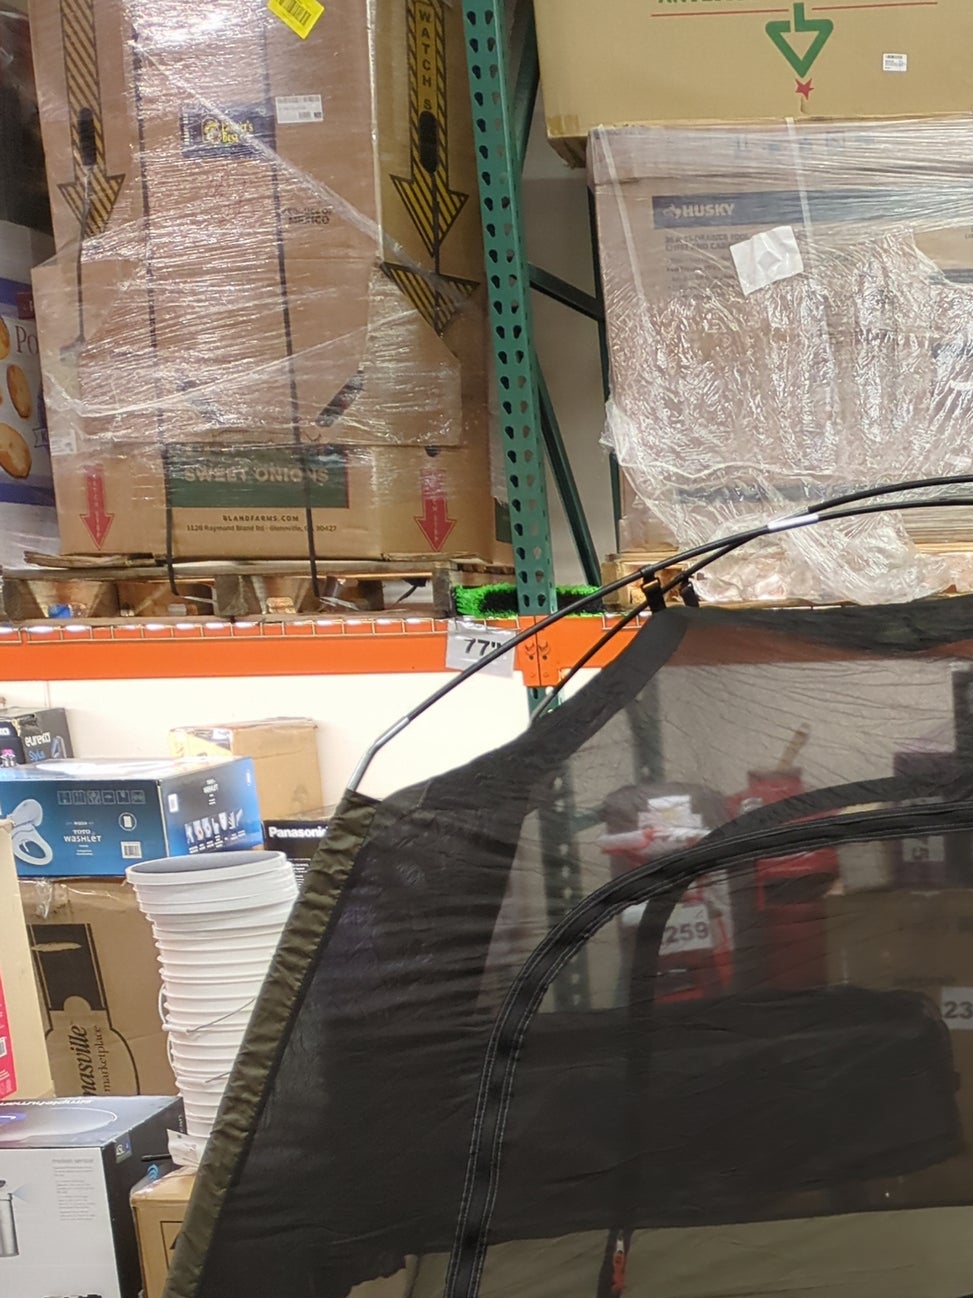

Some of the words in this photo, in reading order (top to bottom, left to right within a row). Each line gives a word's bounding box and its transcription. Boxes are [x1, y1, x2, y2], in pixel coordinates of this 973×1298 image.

[418, 9, 432, 88] WATCH
[682, 202, 735, 217] HUSKY
[184, 467, 248, 482] SWEET
[255, 467, 329, 484] ONIONS
[25, 732, 51, 747] eureka
[94, 1025, 111, 1092] marketplace
